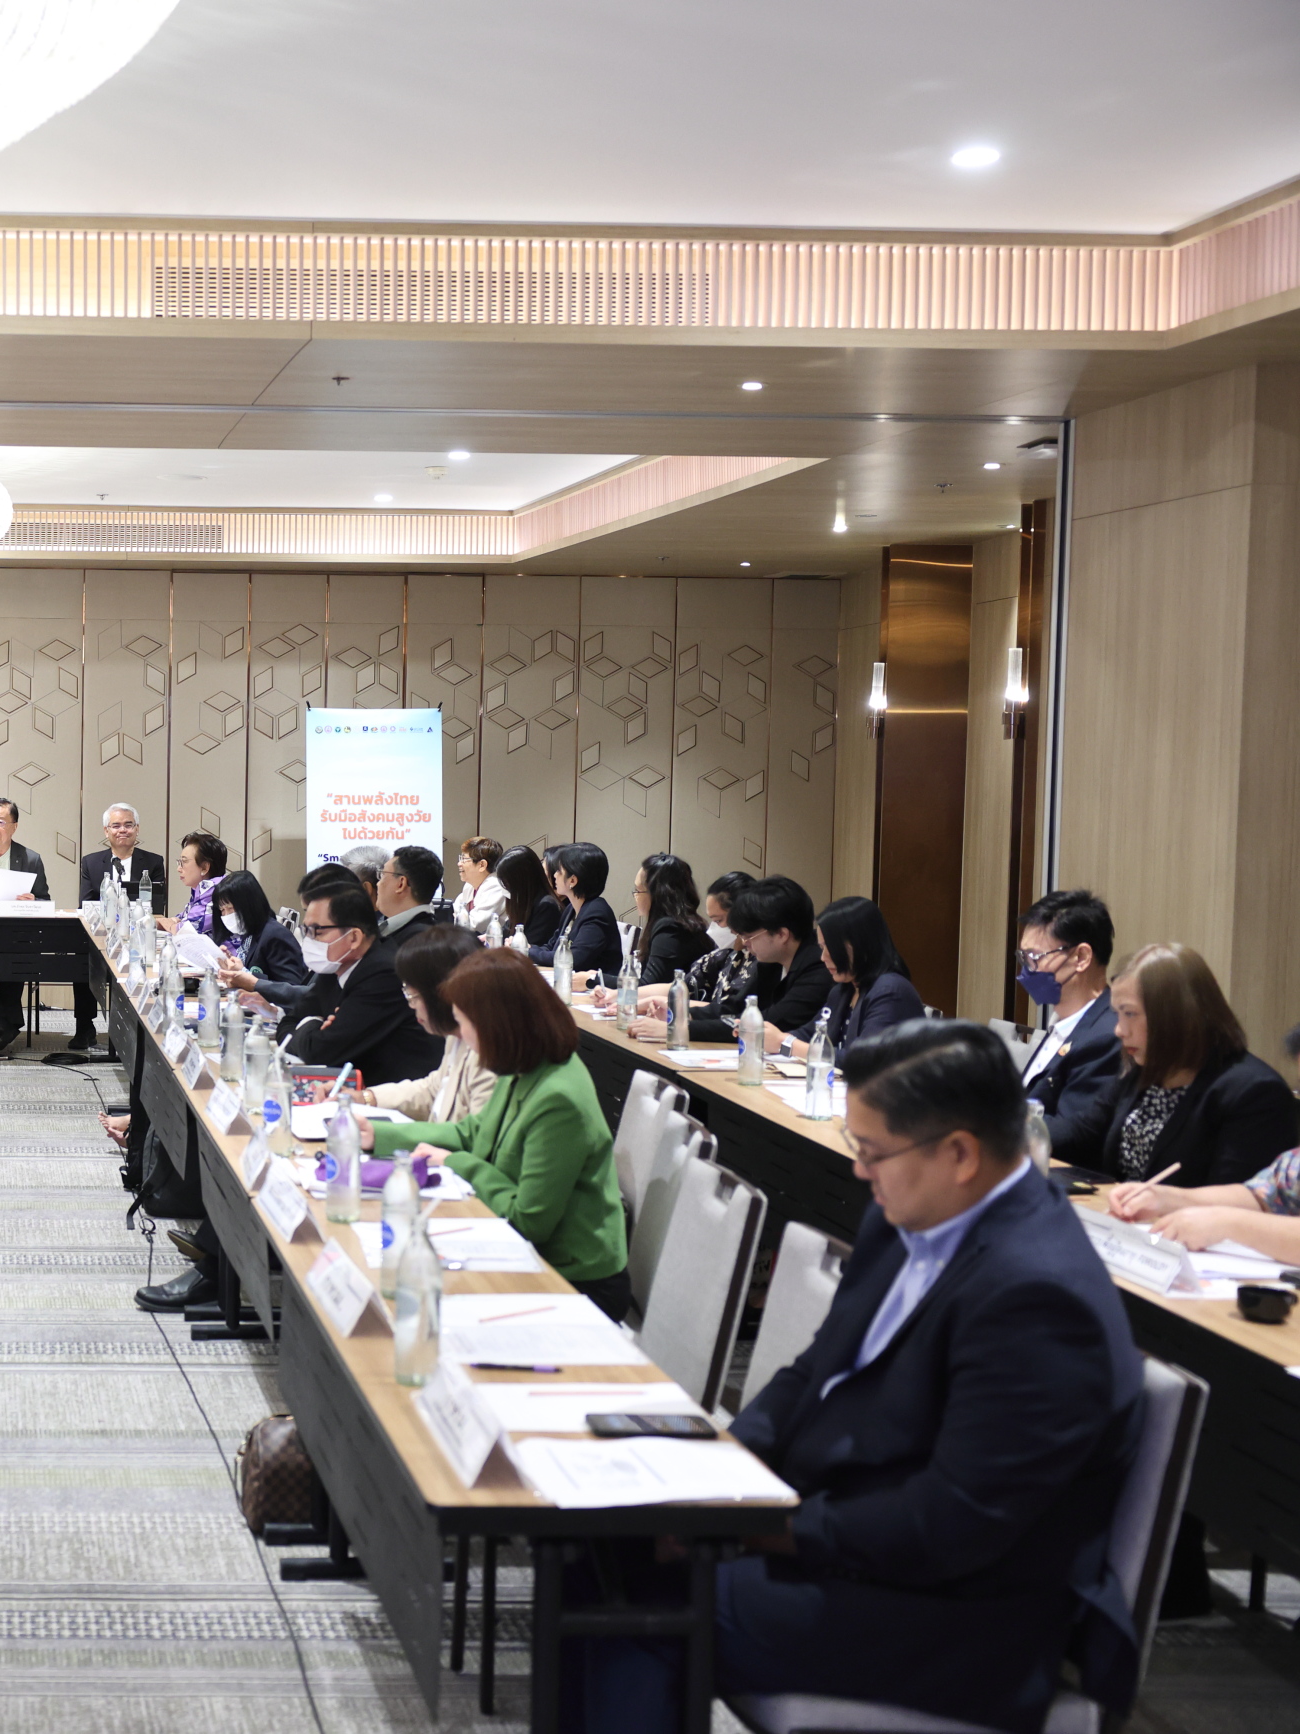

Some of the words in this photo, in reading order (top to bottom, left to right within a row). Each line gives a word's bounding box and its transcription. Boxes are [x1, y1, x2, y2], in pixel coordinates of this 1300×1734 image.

[320, 809, 432, 826] รับมือสังคมสูงวัย
